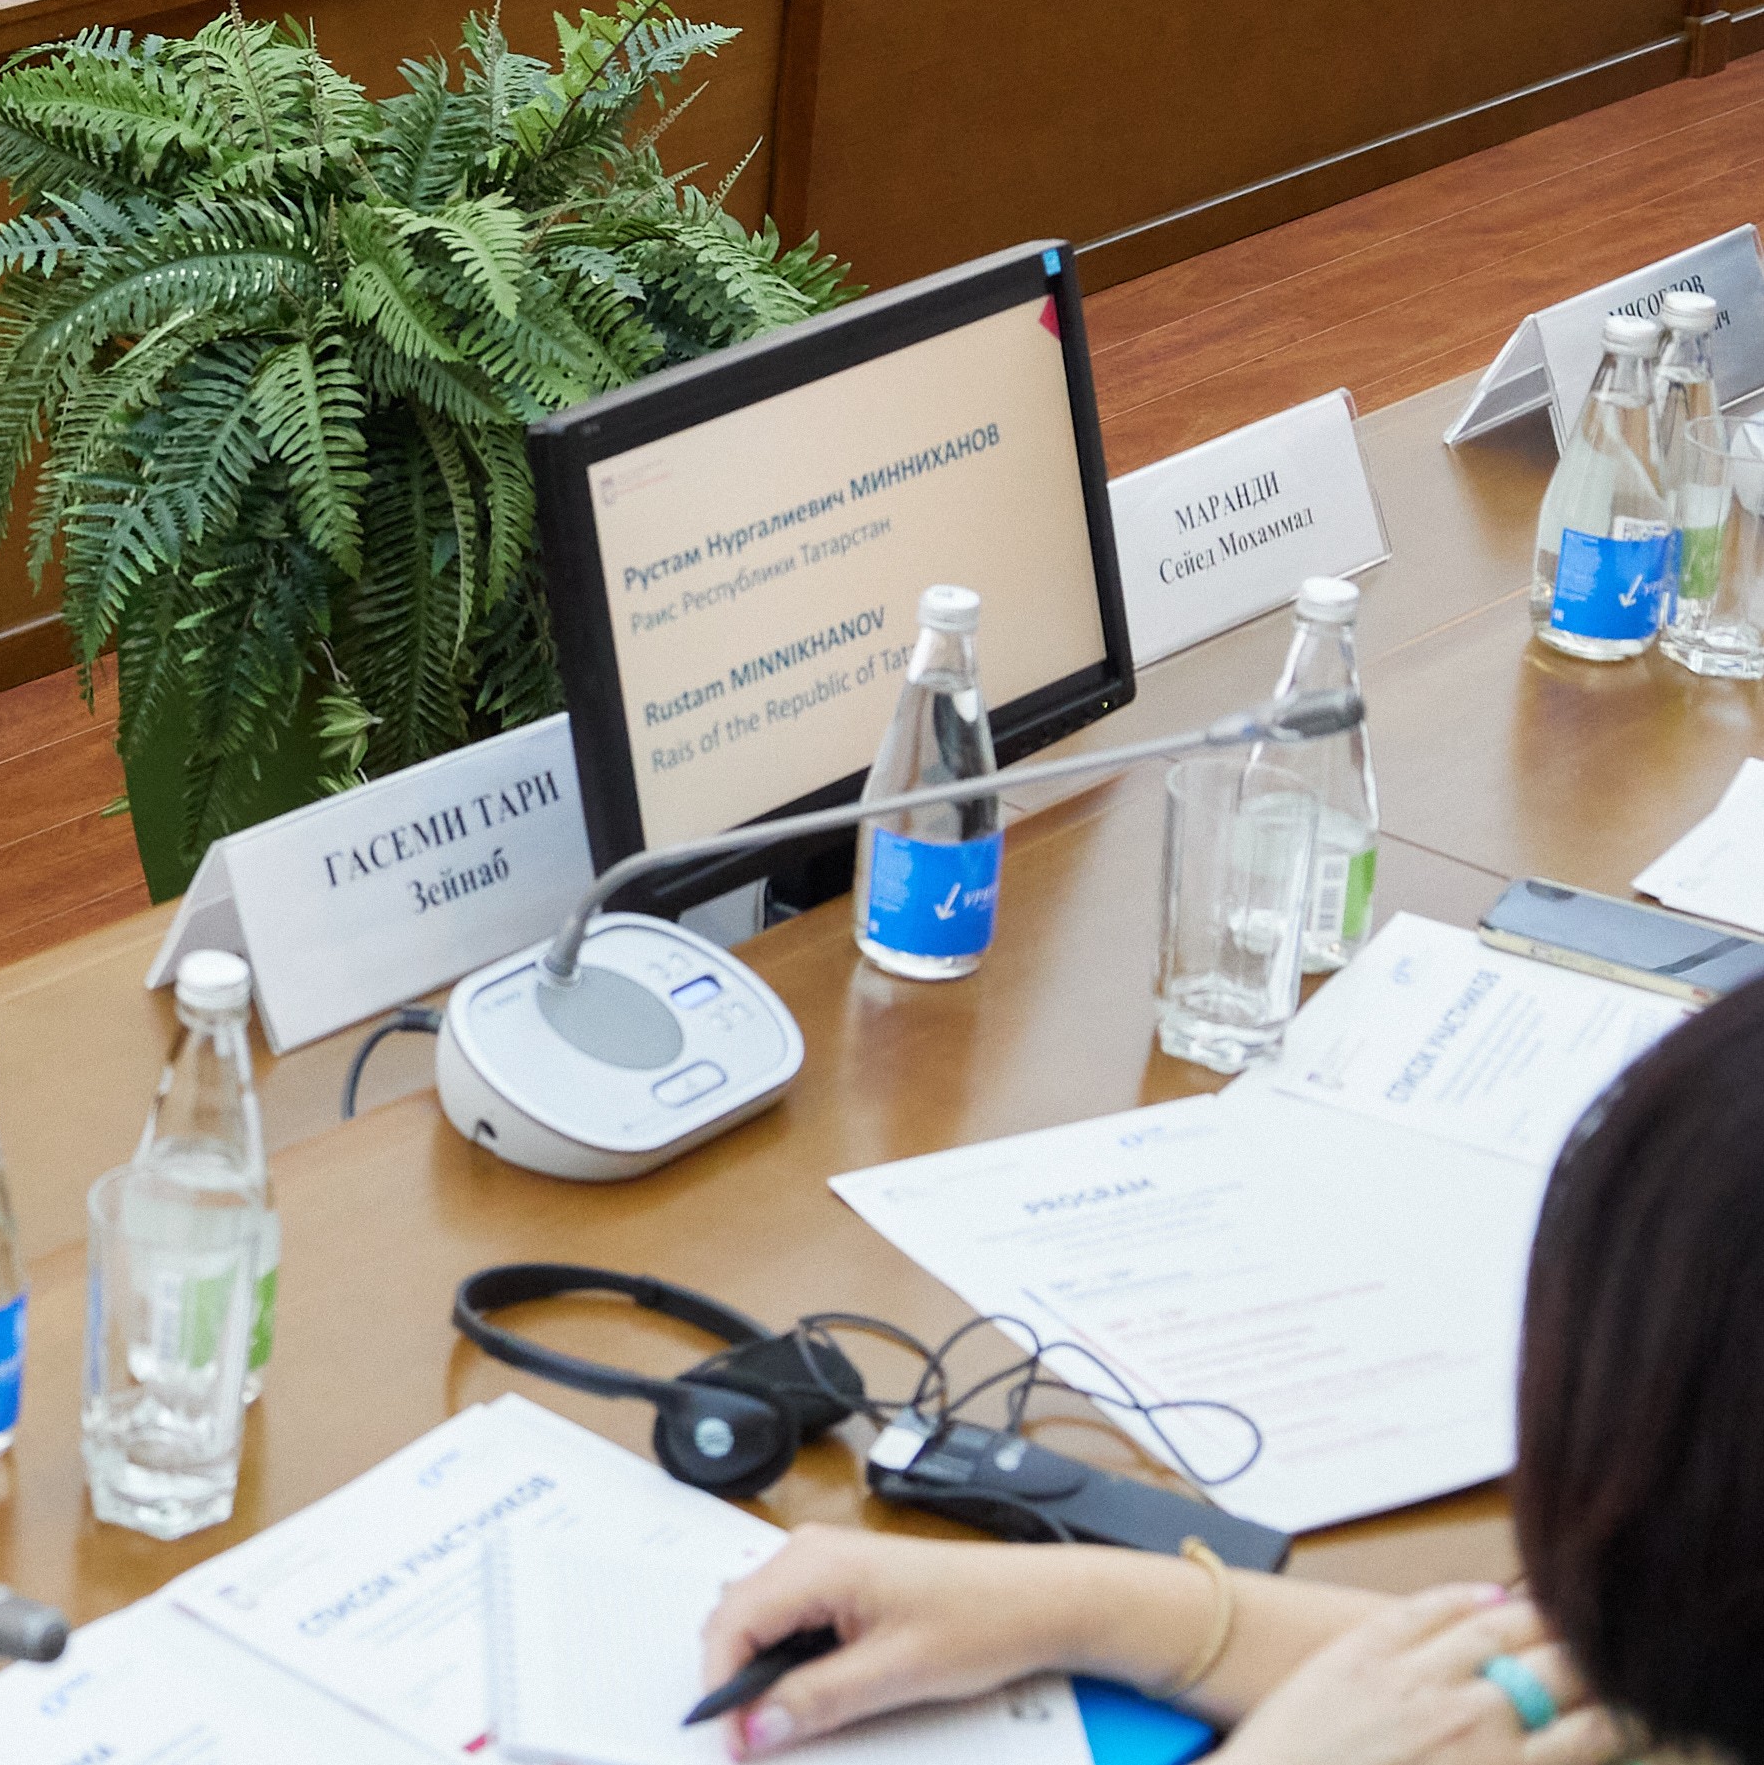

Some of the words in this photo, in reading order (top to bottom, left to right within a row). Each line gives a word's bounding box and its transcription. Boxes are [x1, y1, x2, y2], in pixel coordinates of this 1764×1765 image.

[623, 547, 701, 590] Рустам
[706, 491, 844, 556] Нургалиевич
[848, 422, 1000, 500] МИННИХАНОВ
[1158, 548, 1216, 584] Сейед
[1218, 507, 1313, 557] Мохаммад
[1174, 470, 1280, 533] МАРАНДИ
[630, 603, 676, 634] Раис
[681, 556, 795, 611] Республики
[799, 517, 891, 564] Татарстан
[644, 682, 726, 725] Rustam
[730, 607, 885, 693] MINNIKHANOV
[650, 742, 694, 772] Rais
[700, 722, 719, 752] of
[724, 713, 759, 741] the
[765, 672, 850, 721] Republic
[855, 658, 875, 685] of
[324, 815, 468, 888] ГАСЕМИ
[473, 771, 560, 830] ТАРИ
[408, 848, 510, 912] Зейнаб
